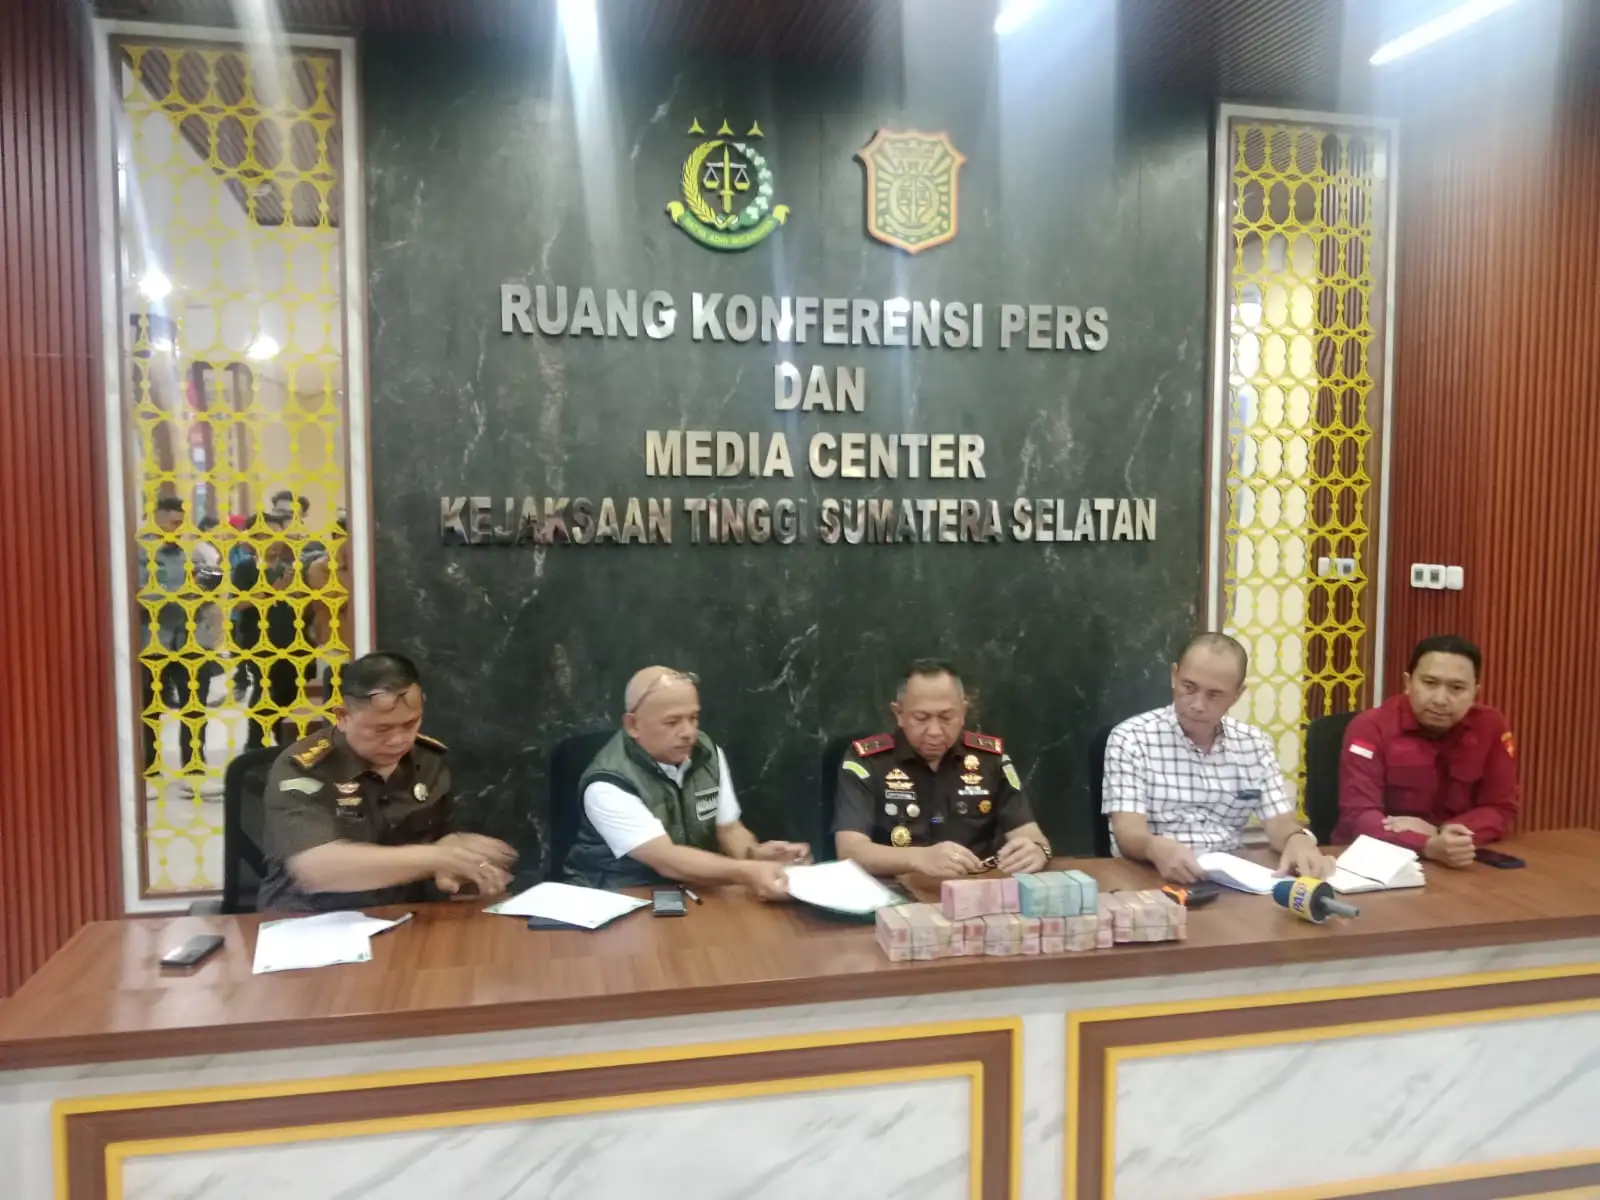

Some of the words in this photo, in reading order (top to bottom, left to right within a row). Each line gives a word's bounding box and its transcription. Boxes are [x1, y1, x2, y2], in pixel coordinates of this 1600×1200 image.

[500, 284, 678, 339] RUANG
[691, 292, 983, 348] KONFERENSI
[1000, 303, 1109, 351] PERS
[773, 361, 866, 412] DAN
[645, 430, 795, 477] MEDIA
[808, 432, 986, 478] CENTER
[440, 497, 672, 544] KEJAKSAAN
[684, 498, 807, 544] TINGGI
[818, 498, 1003, 544] SUMATERA
[1012, 498, 1157, 542] SELATAN
